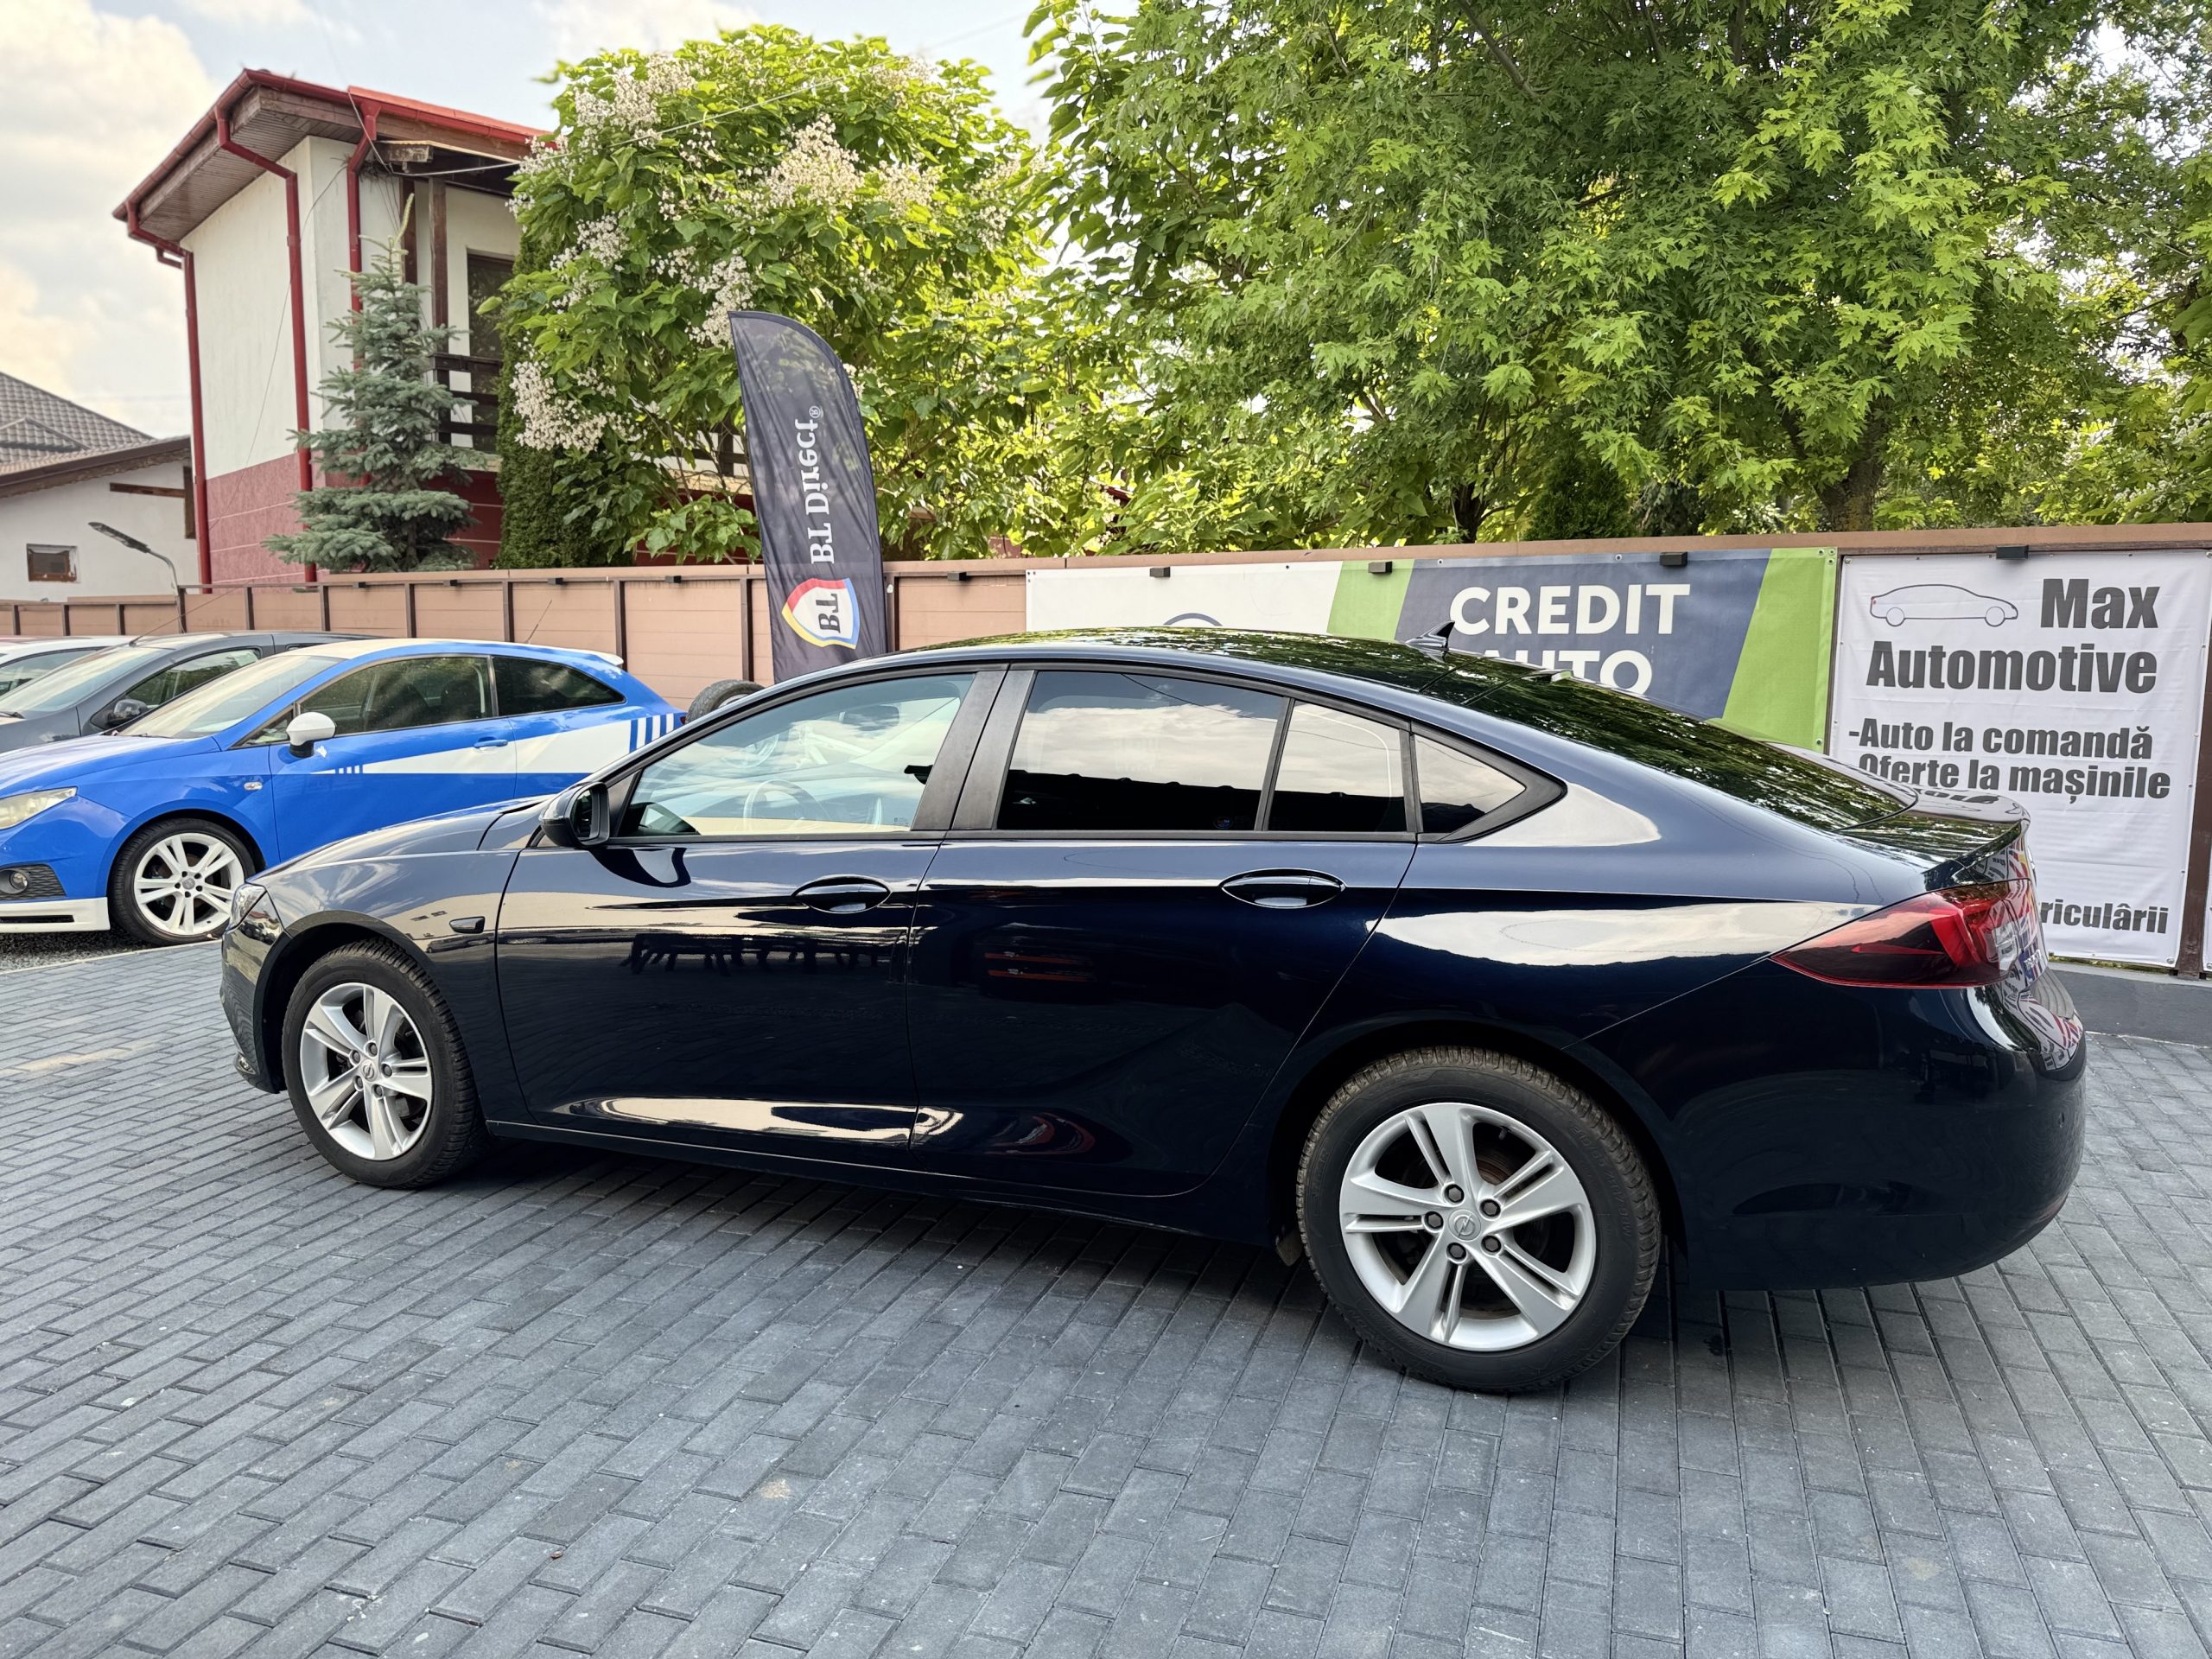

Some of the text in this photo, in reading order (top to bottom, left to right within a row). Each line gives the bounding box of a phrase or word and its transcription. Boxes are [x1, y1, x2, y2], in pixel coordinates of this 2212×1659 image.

[1450, 583, 1691, 635] CREDIT
[2041, 578, 2161, 629] Max
[1482, 648, 1653, 694] TO
[1866, 641, 2158, 693] Automotive
[1848, 718, 2153, 760] -Auto la comandă
[1967, 760, 1999, 790] la
[2009, 764, 2171, 804] mașinile
[2038, 899, 2169, 934] riculârii
